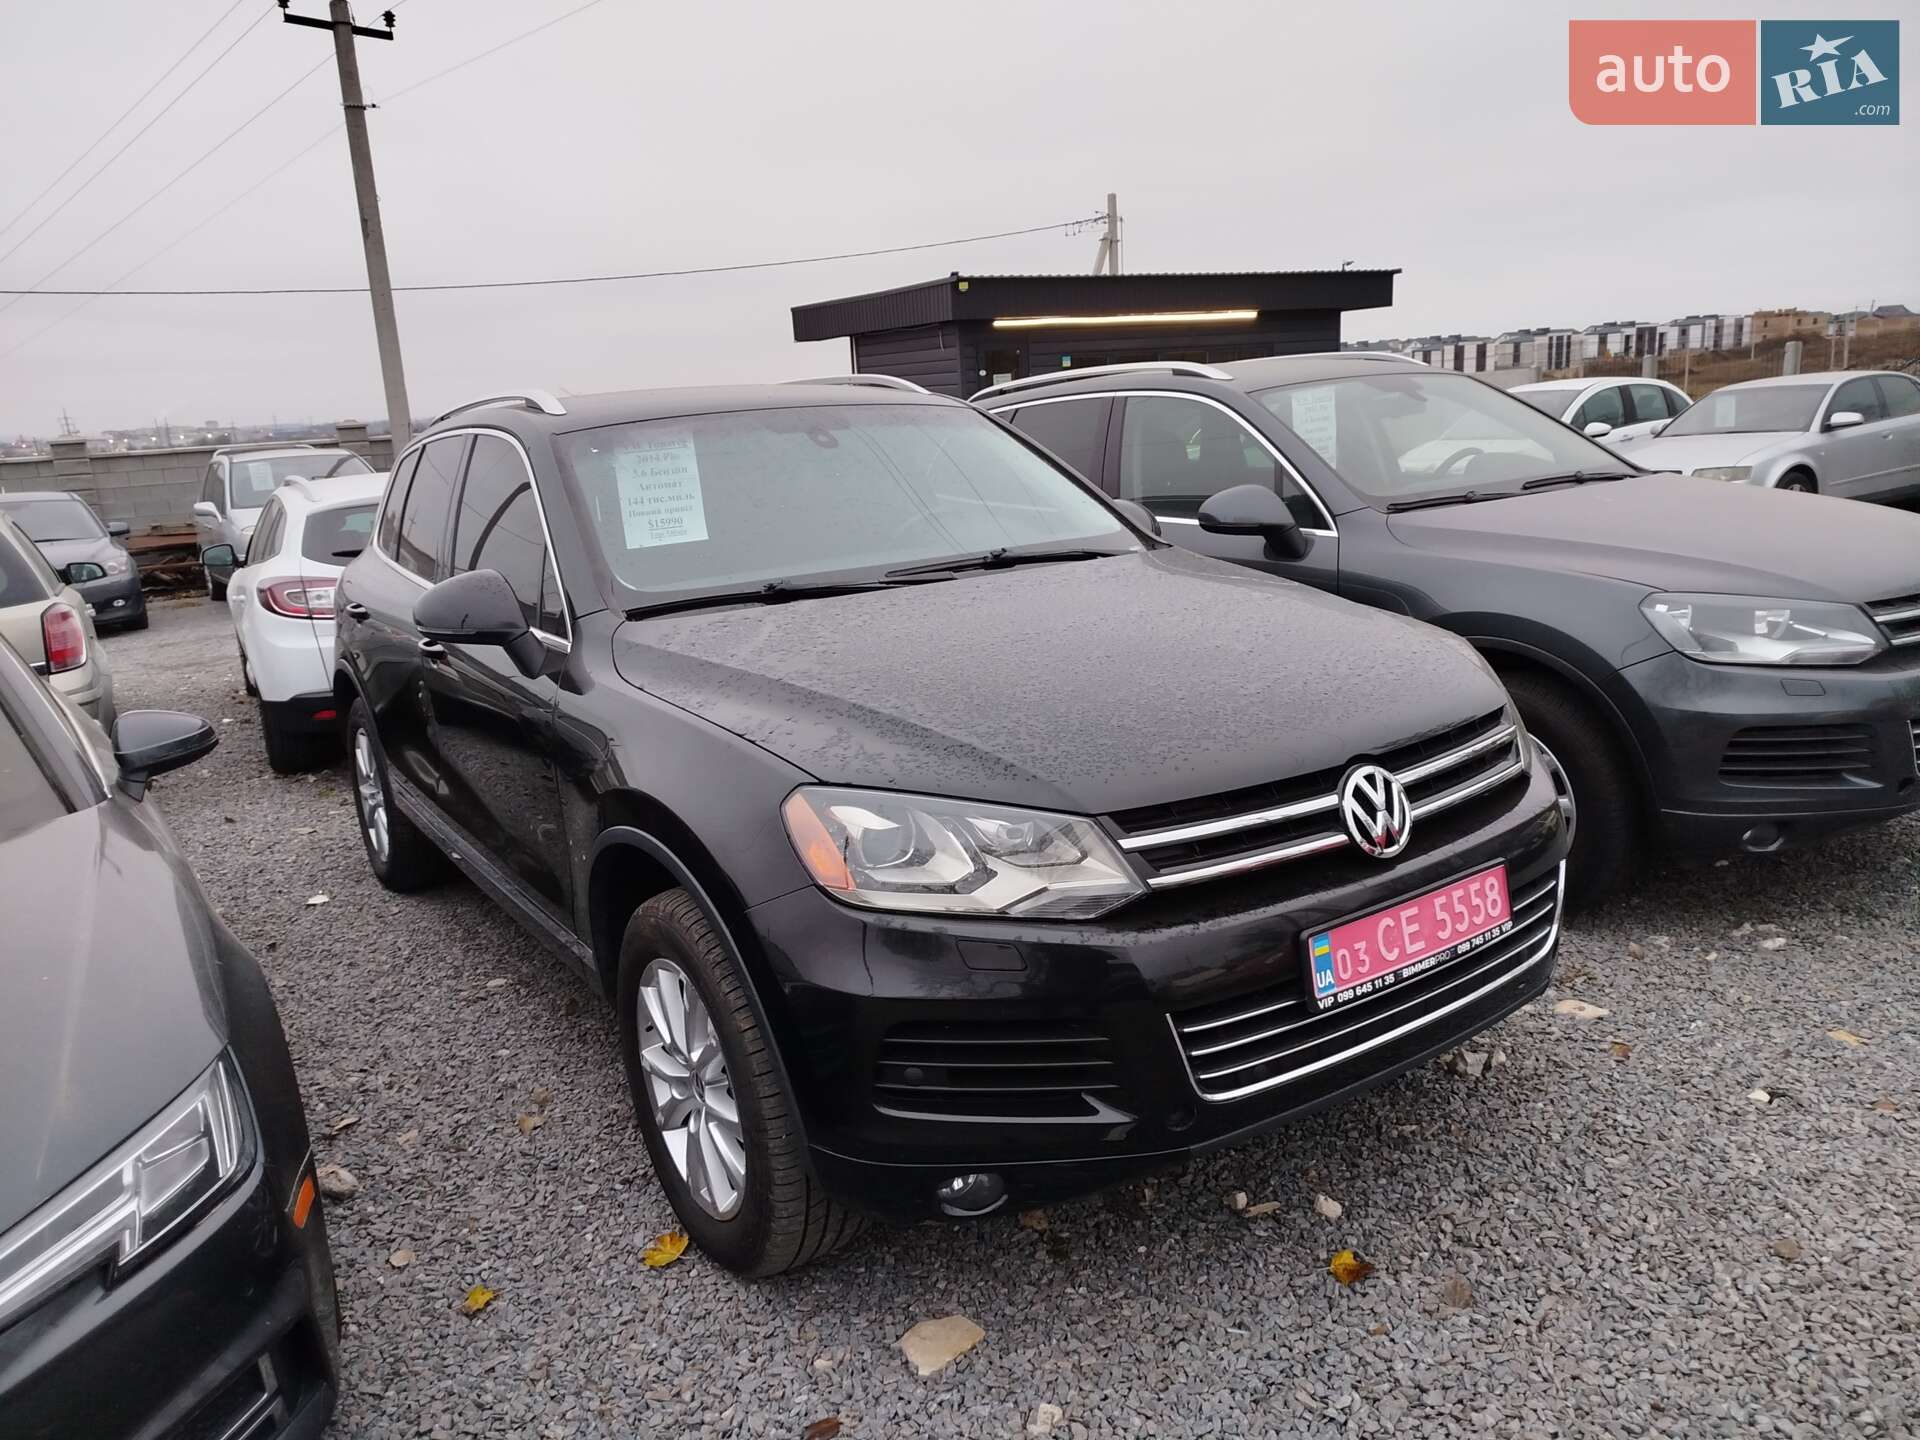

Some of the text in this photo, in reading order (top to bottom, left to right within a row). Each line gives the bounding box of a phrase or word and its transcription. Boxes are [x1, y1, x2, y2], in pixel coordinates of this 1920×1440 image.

[648, 516, 684, 529] $15990
[1336, 876, 1503, 980] 03 CE 5558
[1316, 971, 1335, 989] UA
[1317, 997, 1335, 1010] VIP
[1337, 990, 1354, 1003] 099
[1355, 983, 1373, 996] 645
[1374, 979, 1383, 990] 11
[1384, 974, 1395, 986] 35
[1457, 941, 1471, 955] 099
[1471, 935, 1485, 949] 745
[1485, 931, 1491, 943] 11
[1491, 927, 1501, 940] 35
[1501, 921, 1514, 934] VIP
